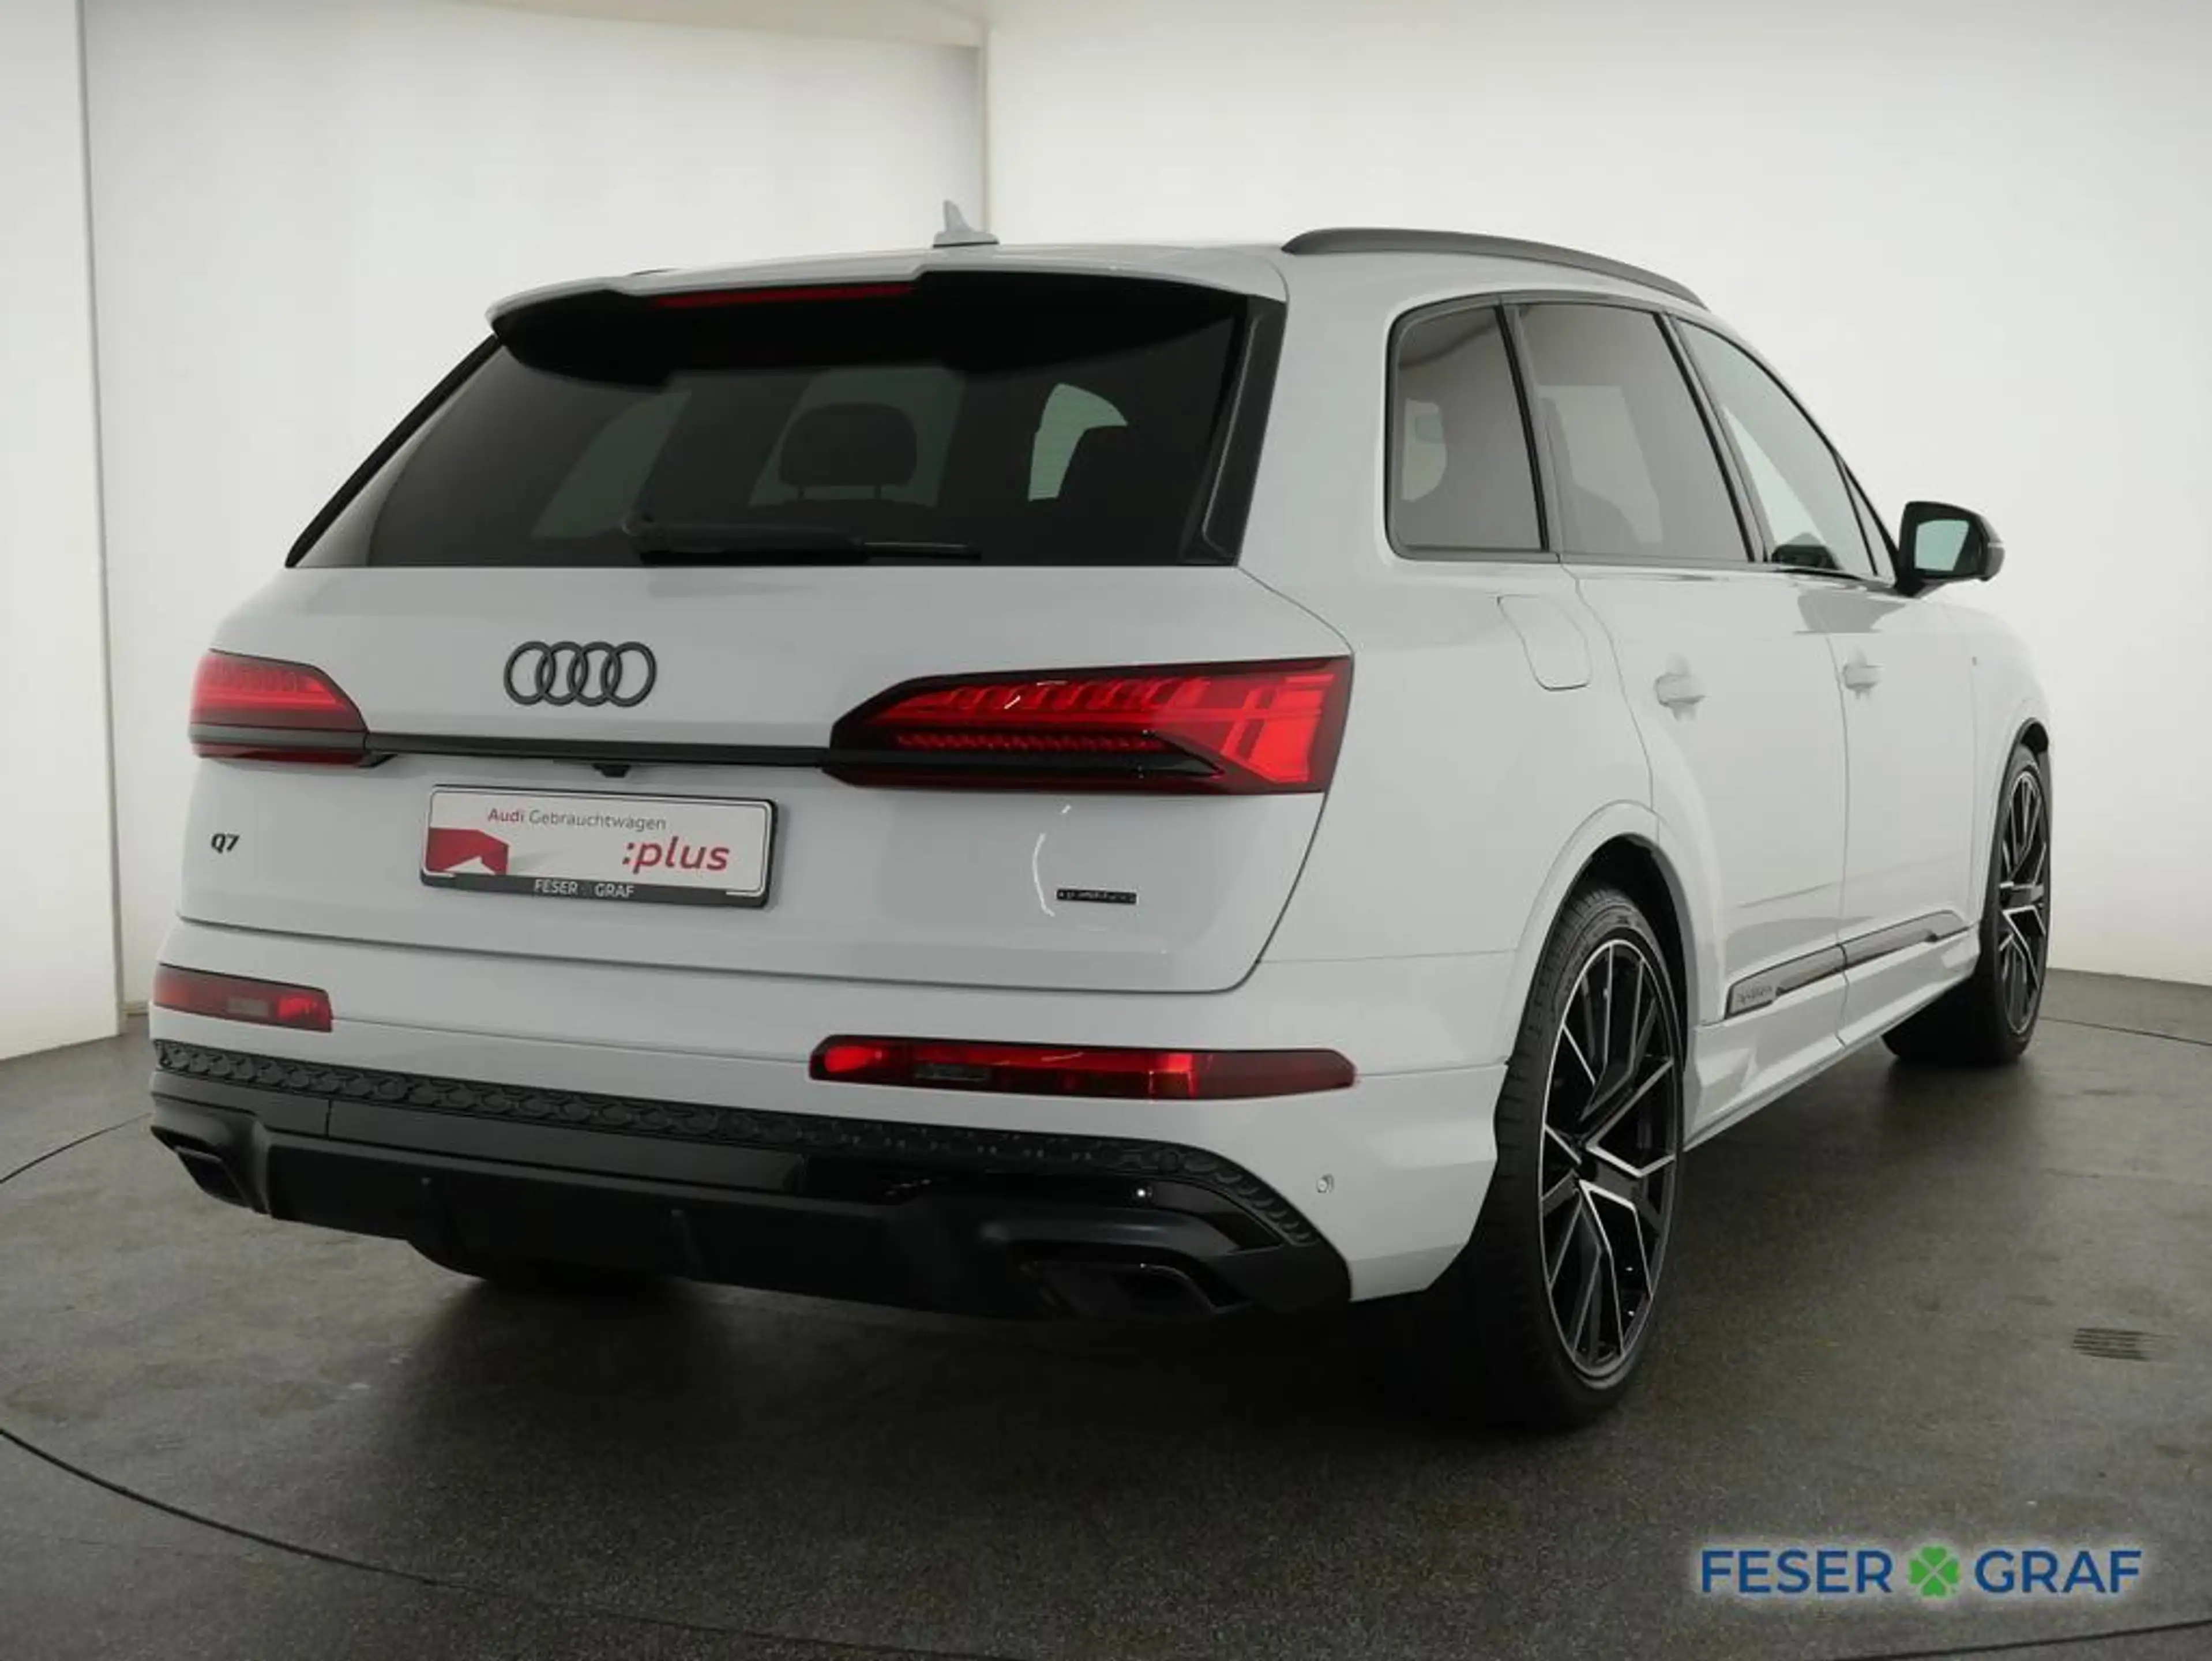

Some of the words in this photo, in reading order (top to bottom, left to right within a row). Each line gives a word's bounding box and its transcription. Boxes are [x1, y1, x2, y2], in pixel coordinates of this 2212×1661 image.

[488, 808, 524, 823] Audi
[528, 809, 666, 832] Gebrauchtwagen
[211, 833, 240, 854] Q7
[622, 836, 730, 874] :plus
[534, 878, 578, 895] FESER
[594, 883, 634, 898] GRAF
